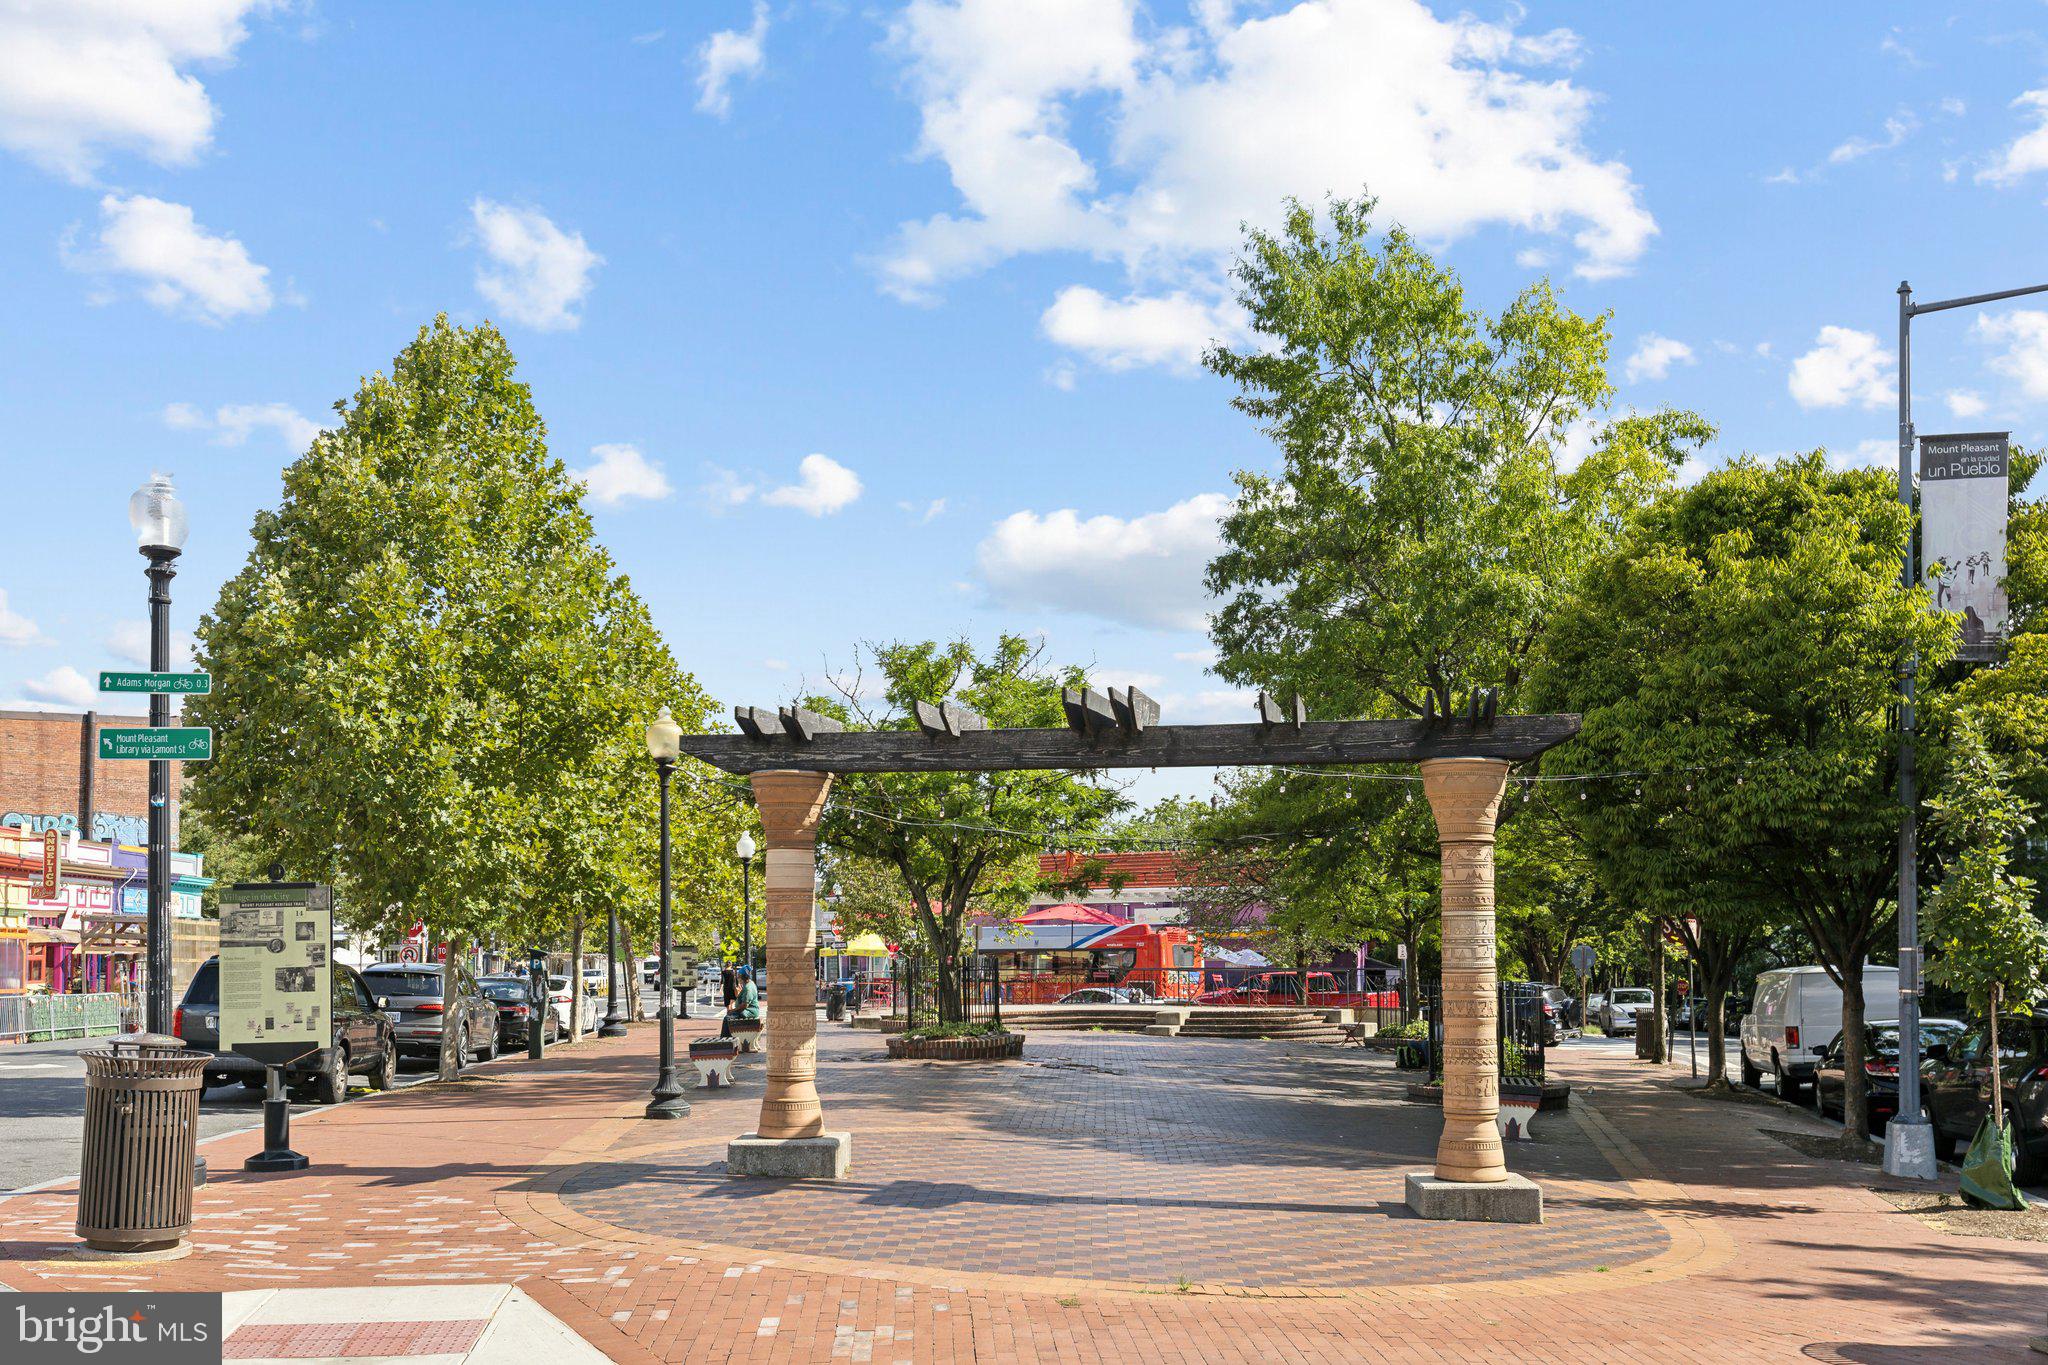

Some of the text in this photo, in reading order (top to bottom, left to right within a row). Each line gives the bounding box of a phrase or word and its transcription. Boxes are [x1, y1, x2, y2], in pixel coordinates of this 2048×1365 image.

[1928, 444, 2000, 454] Mount Pleasant
[1928, 462, 2000, 477] un Pueblo
[117, 678, 208, 689] Adams Morgan 0.3
[116, 734, 168, 743] Mount Pleasant
[116, 745, 186, 755] Library via Lamont St
[45, 831, 56, 887] ANGELICO
[224, 892, 250, 902] Village
[261, 892, 272, 900] the
[274, 892, 290, 901] City
[533, 959, 540, 969] P
